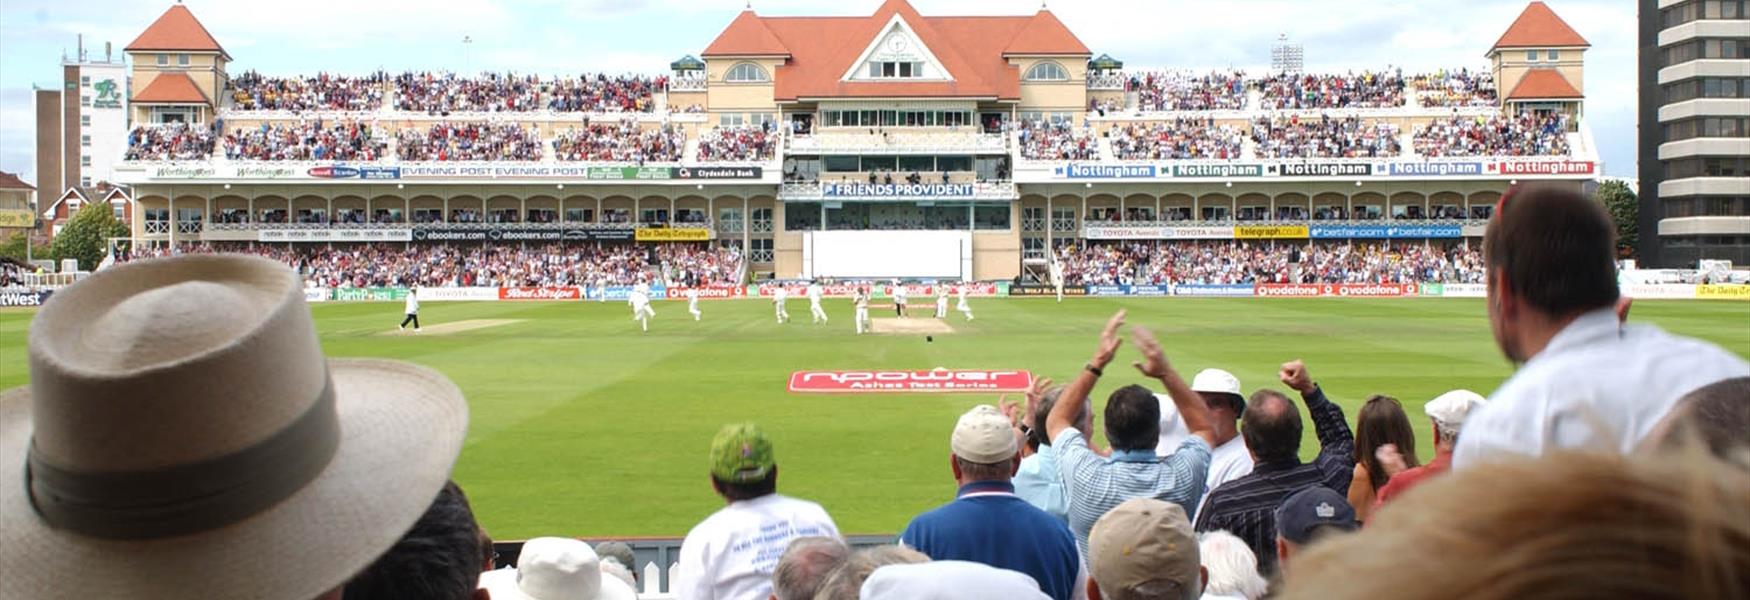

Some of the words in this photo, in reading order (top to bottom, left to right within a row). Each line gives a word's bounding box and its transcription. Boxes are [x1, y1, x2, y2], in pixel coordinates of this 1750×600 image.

[402, 167, 457, 175] EVENING
[460, 167, 493, 175] POST
[495, 167, 550, 175] EVENING
[553, 167, 586, 175] POST
[737, 169, 754, 177] Bank
[1072, 165, 1150, 177] Nottingham
[1178, 165, 1258, 176] Nottingham
[1286, 164, 1366, 175] Nottingham
[1395, 163, 1476, 174] Nottingham
[1506, 162, 1588, 173] Nottingham
[837, 184, 893, 195] FRIENDS
[896, 184, 972, 195] PROVIDENT
[427, 230, 486, 240] ebookers.com
[502, 230, 560, 240] ebookers.com
[1323, 227, 1385, 236] betfair.com
[1400, 227, 1461, 236] betfair.com
[1267, 284, 1318, 295] vodafone
[1349, 284, 1400, 295] vodafone
[0, 292, 41, 306] tWest
[804, 371, 1018, 384] npower
[850, 381, 904, 389] Ashes
[909, 381, 941, 389] Test
[945, 381, 998, 389] Series
